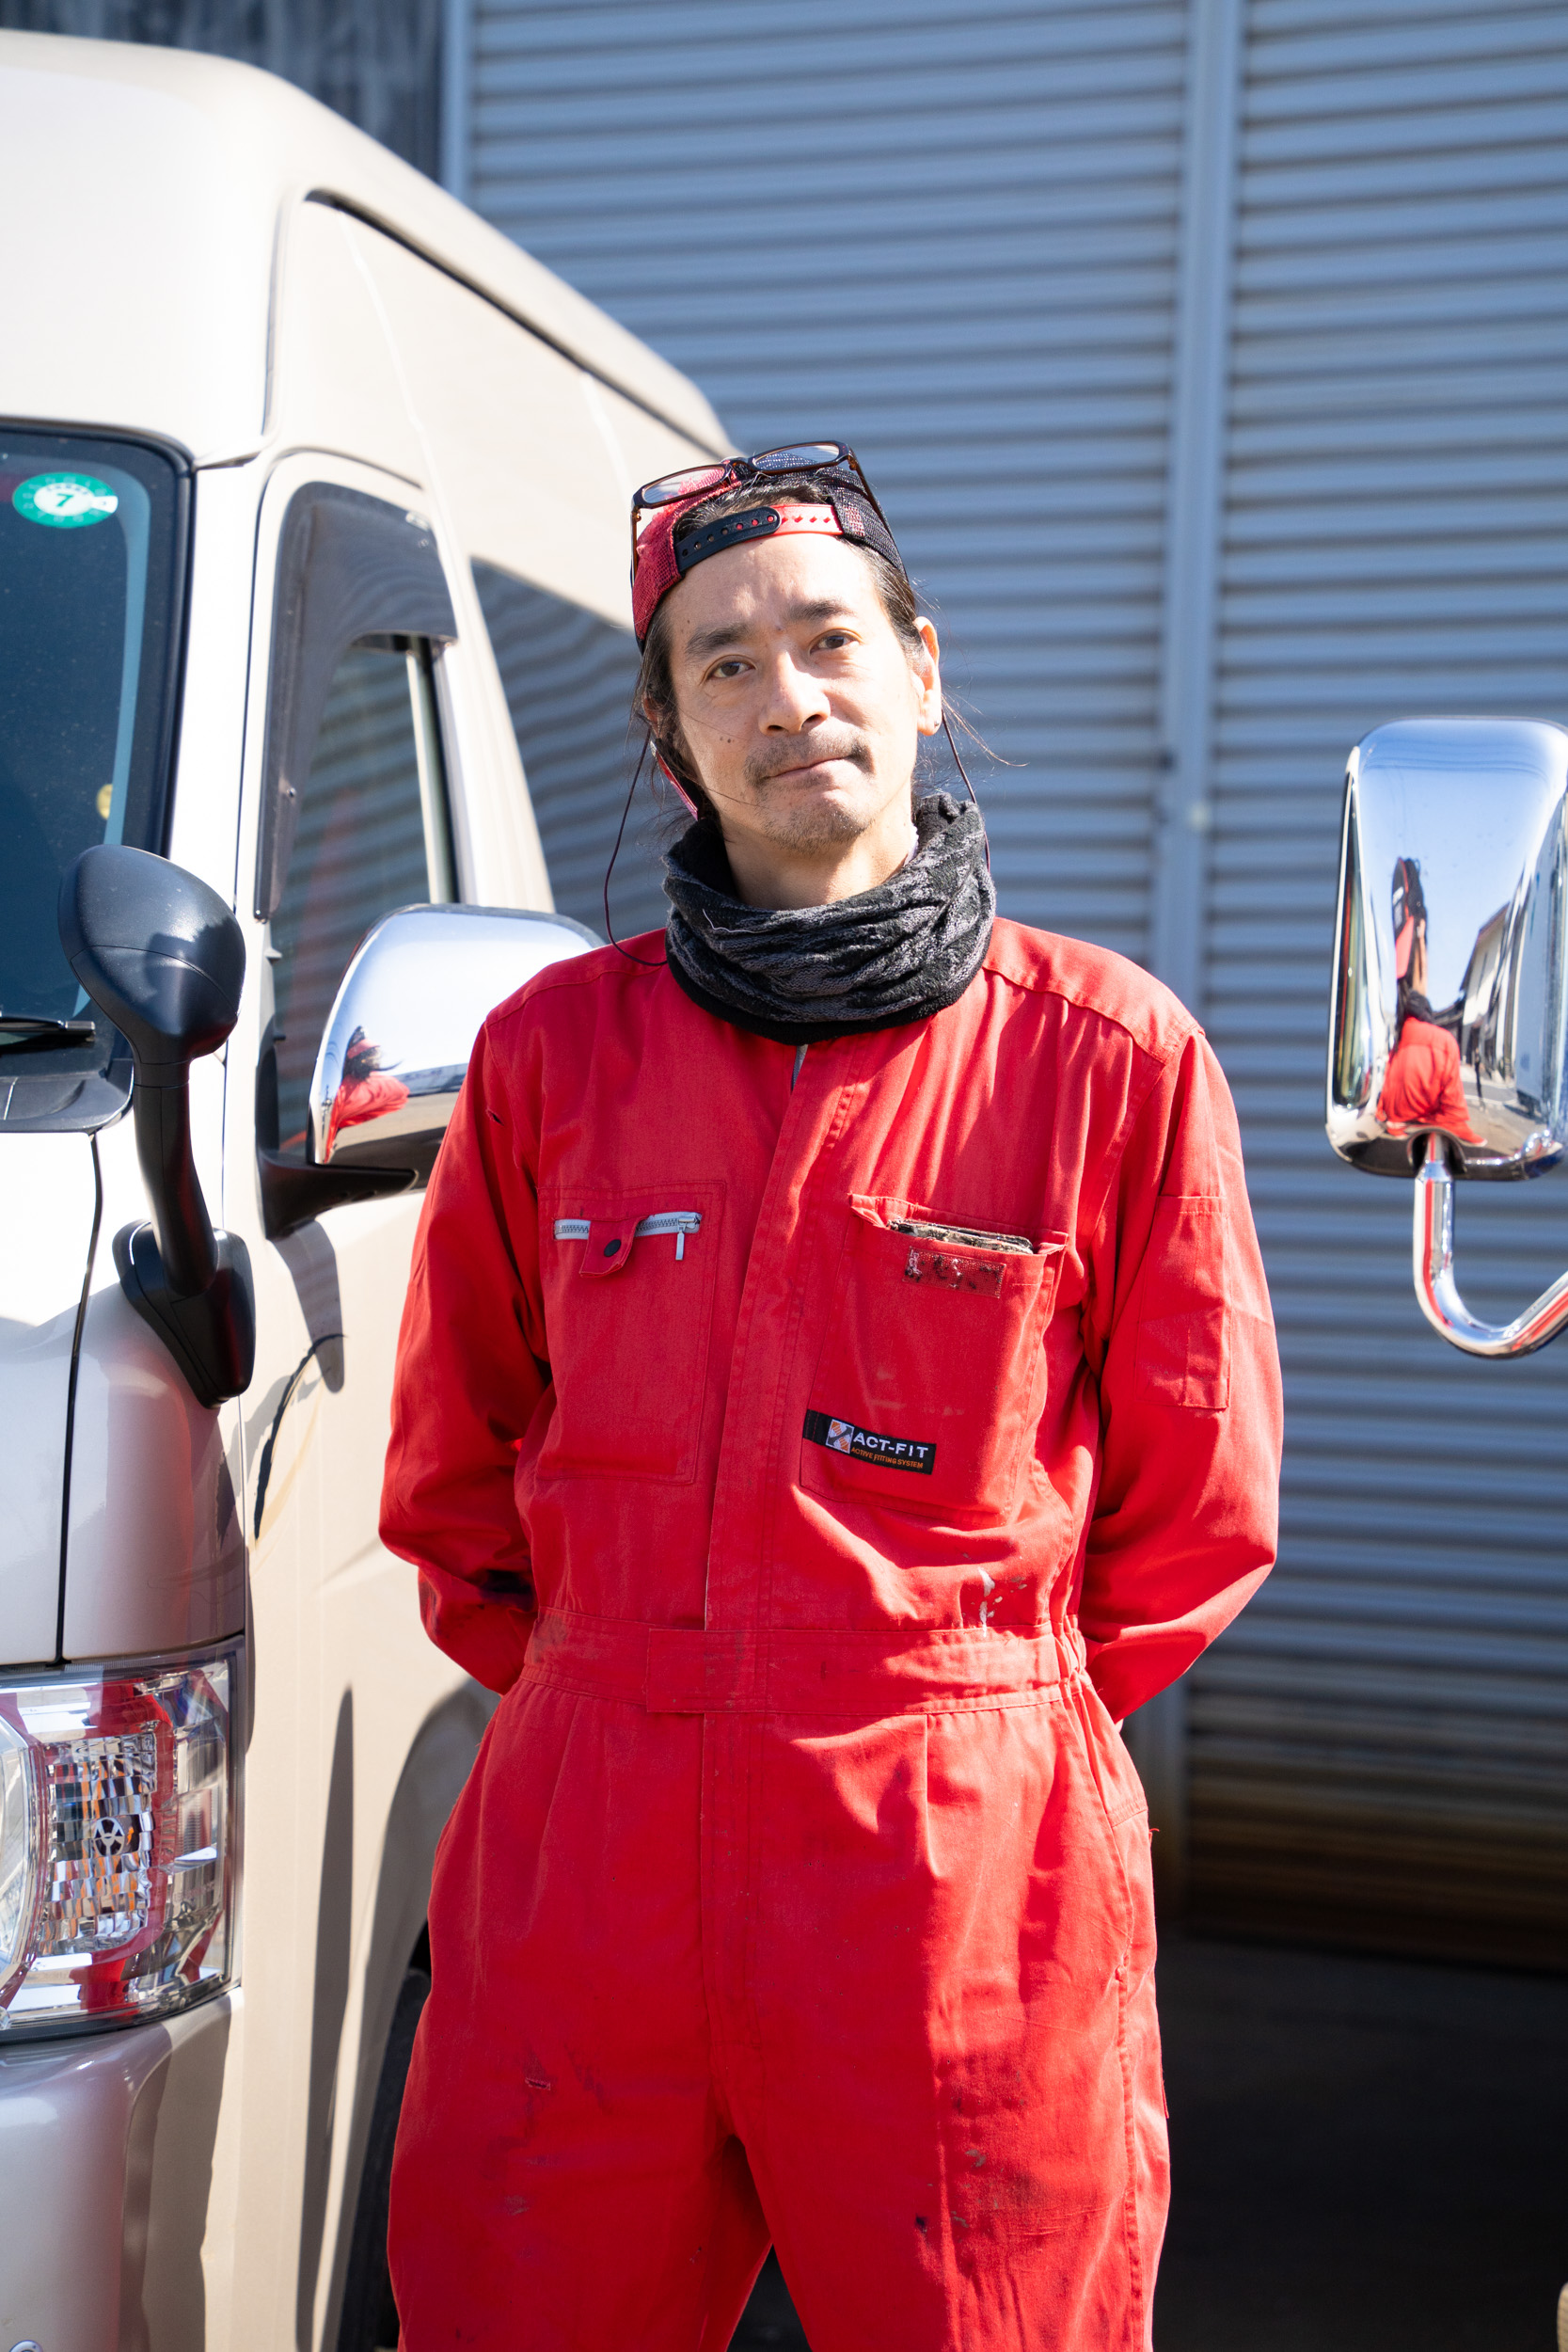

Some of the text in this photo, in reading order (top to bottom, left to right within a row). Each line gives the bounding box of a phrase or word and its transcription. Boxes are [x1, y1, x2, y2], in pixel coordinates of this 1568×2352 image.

[56, 493, 74, 507] 7
[853, 1432, 928, 1458] ACT-FIT
[850, 1447, 924, 1469] ACTIVE FITTING SYSTEM
